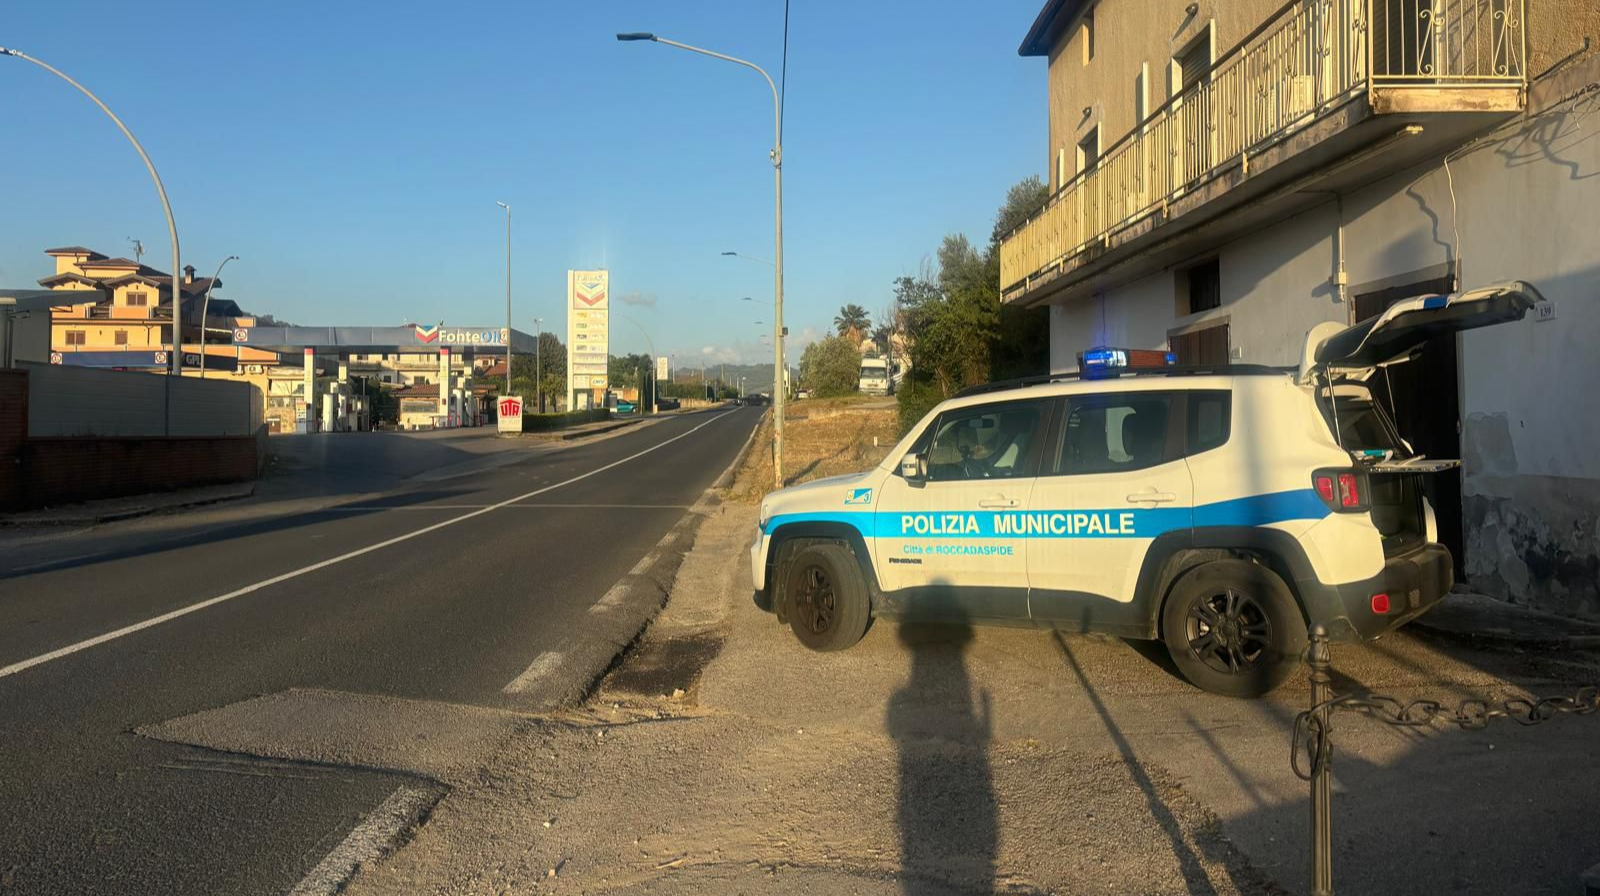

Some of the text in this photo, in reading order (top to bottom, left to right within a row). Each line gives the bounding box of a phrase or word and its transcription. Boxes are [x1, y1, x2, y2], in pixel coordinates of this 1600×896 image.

[500, 399, 520, 417] UTA
[901, 512, 1136, 535] POLIZIA MUNICIPALE
[936, 545, 1014, 555] ROCCADASPIDE
